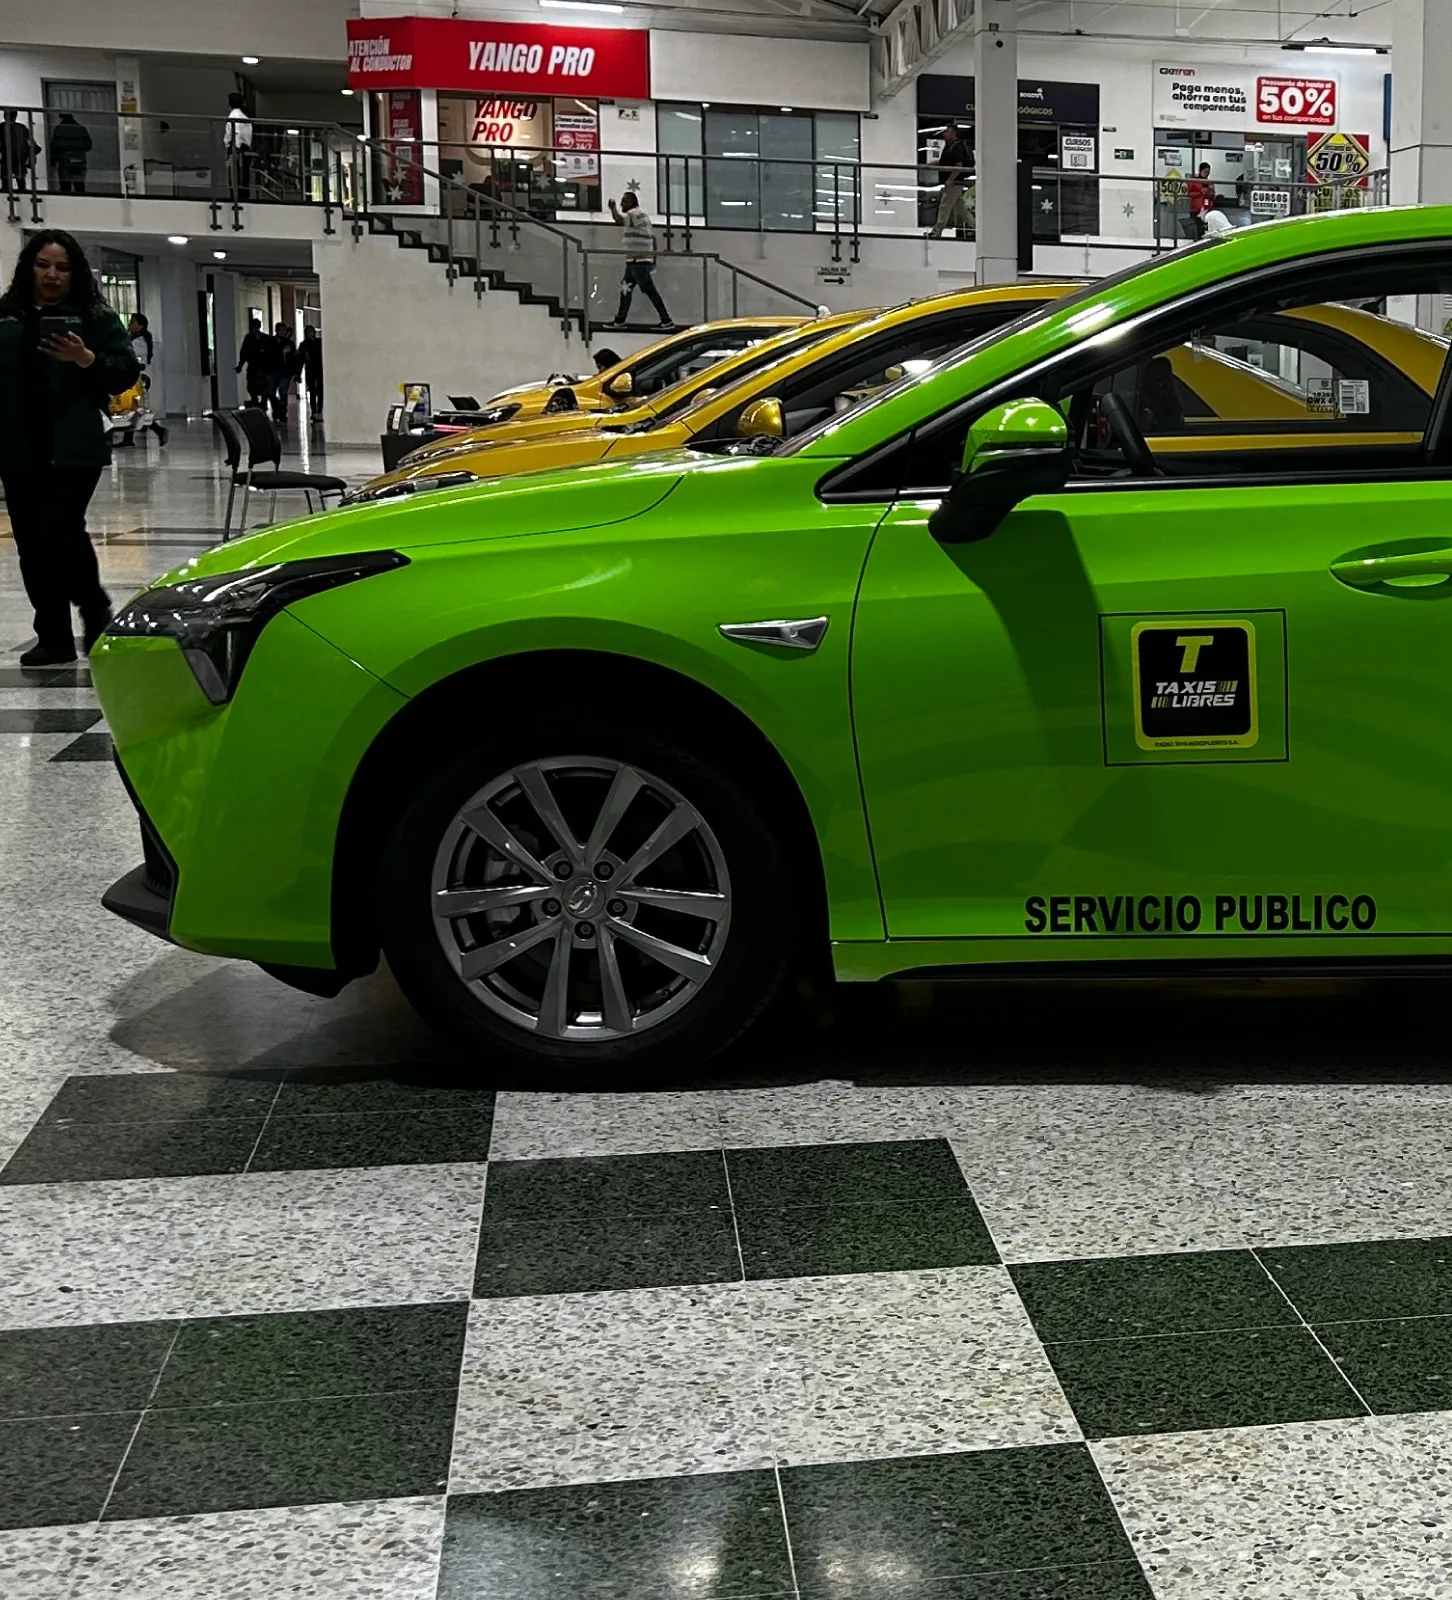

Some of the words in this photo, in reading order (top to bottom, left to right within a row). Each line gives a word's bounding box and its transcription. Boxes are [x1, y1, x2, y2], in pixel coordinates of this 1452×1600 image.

[348, 35, 390, 56] ATENCIÓN
[350, 56, 361, 72] AL
[363, 54, 412, 72] CONDUCTOR
[469, 41, 543, 73] YANGO
[547, 45, 595, 77] PRO
[1172, 82, 1202, 95] Paga
[1204, 86, 1245, 95] menos,
[1172, 92, 1211, 102] ahorra
[1213, 95, 1226, 103] en
[1228, 95, 1247, 104] tus
[473, 100, 538, 121] YANGO
[1183, 102, 1246, 113] comparendos
[1259, 86, 1334, 117] 50%
[471, 120, 514, 142] PRO
[1064, 138, 1092, 146] CURSOS
[1316, 152, 1361, 172] 50%
[1253, 192, 1288, 203] CURSOS
[1175, 635, 1214, 673] T
[1155, 681, 1218, 695] TAXIS
[1172, 694, 1236, 708] LIBRES
[1024, 895, 1202, 933] SERVICIO
[1215, 894, 1377, 931] PUBLICO
